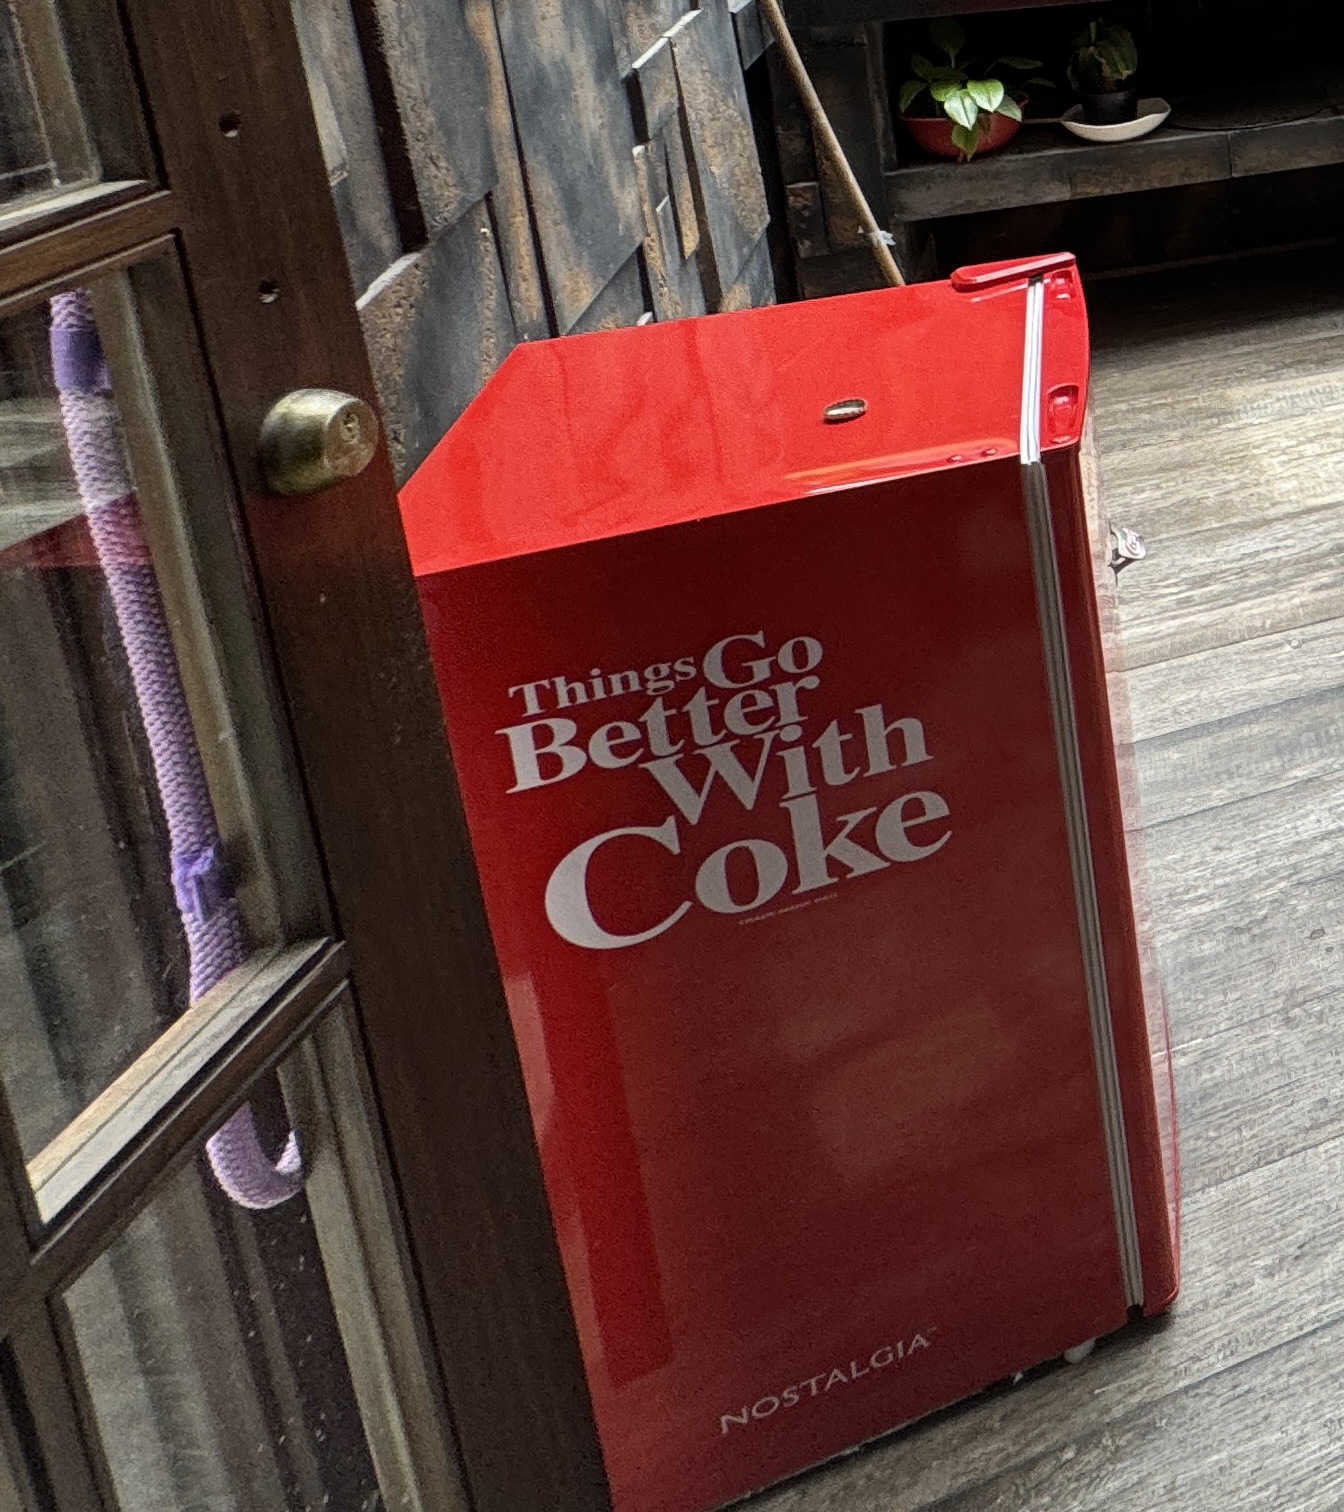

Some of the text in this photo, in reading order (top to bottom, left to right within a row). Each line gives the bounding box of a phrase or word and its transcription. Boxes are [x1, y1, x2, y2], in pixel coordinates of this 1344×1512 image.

[507, 630, 824, 717] Things Go
[495, 675, 820, 795] Better
[639, 703, 934, 826] With
[544, 790, 953, 950] Coke
[720, 1333, 930, 1435] NOSTALGIA
